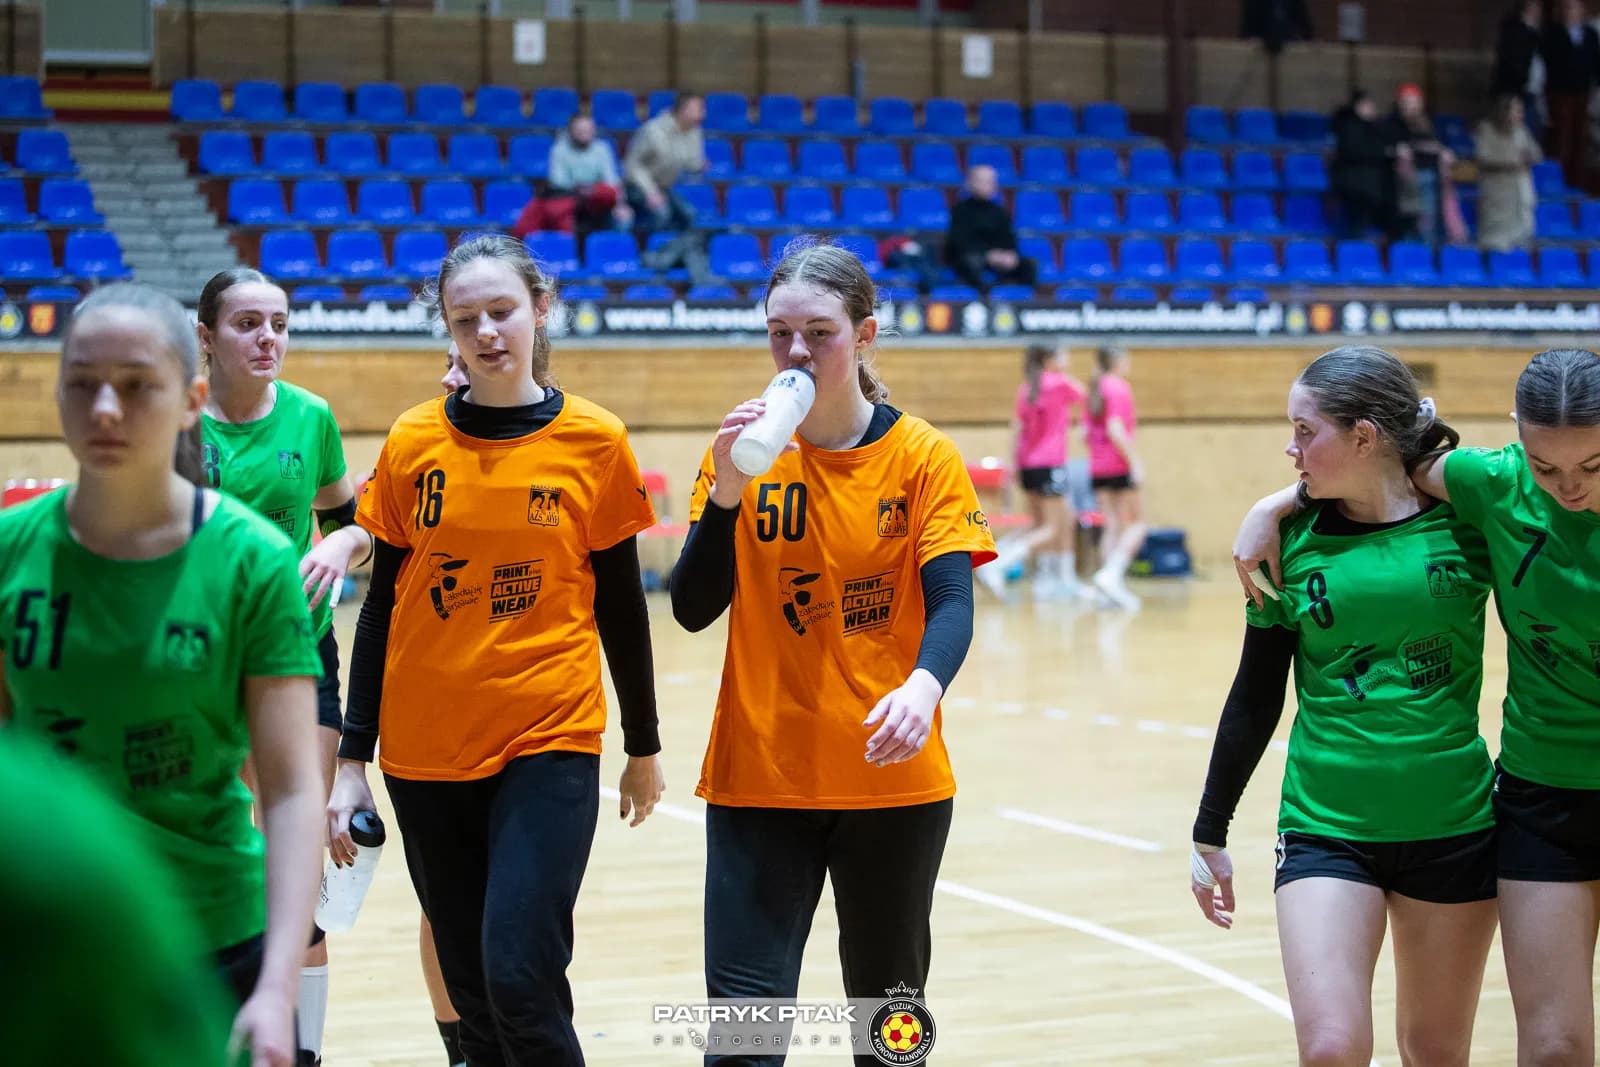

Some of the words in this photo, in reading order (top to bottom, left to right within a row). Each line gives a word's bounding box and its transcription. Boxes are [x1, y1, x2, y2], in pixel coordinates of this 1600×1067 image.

[413, 468, 446, 531] 16
[756, 482, 808, 542] 50
[1511, 526, 1547, 588] 7
[493, 564, 532, 581] PRINT
[492, 577, 541, 598] ACTIVE
[844, 577, 882, 594] PRINT
[491, 593, 538, 615] WEAR
[843, 589, 893, 611] ACTIVE
[1306, 571, 1335, 629] 8
[12, 589, 72, 670] 51
[843, 605, 890, 629] WEAR
[1404, 636, 1441, 658] PRINT
[1407, 645, 1452, 672] ACTIVE
[1410, 661, 1452, 690] WEAR
